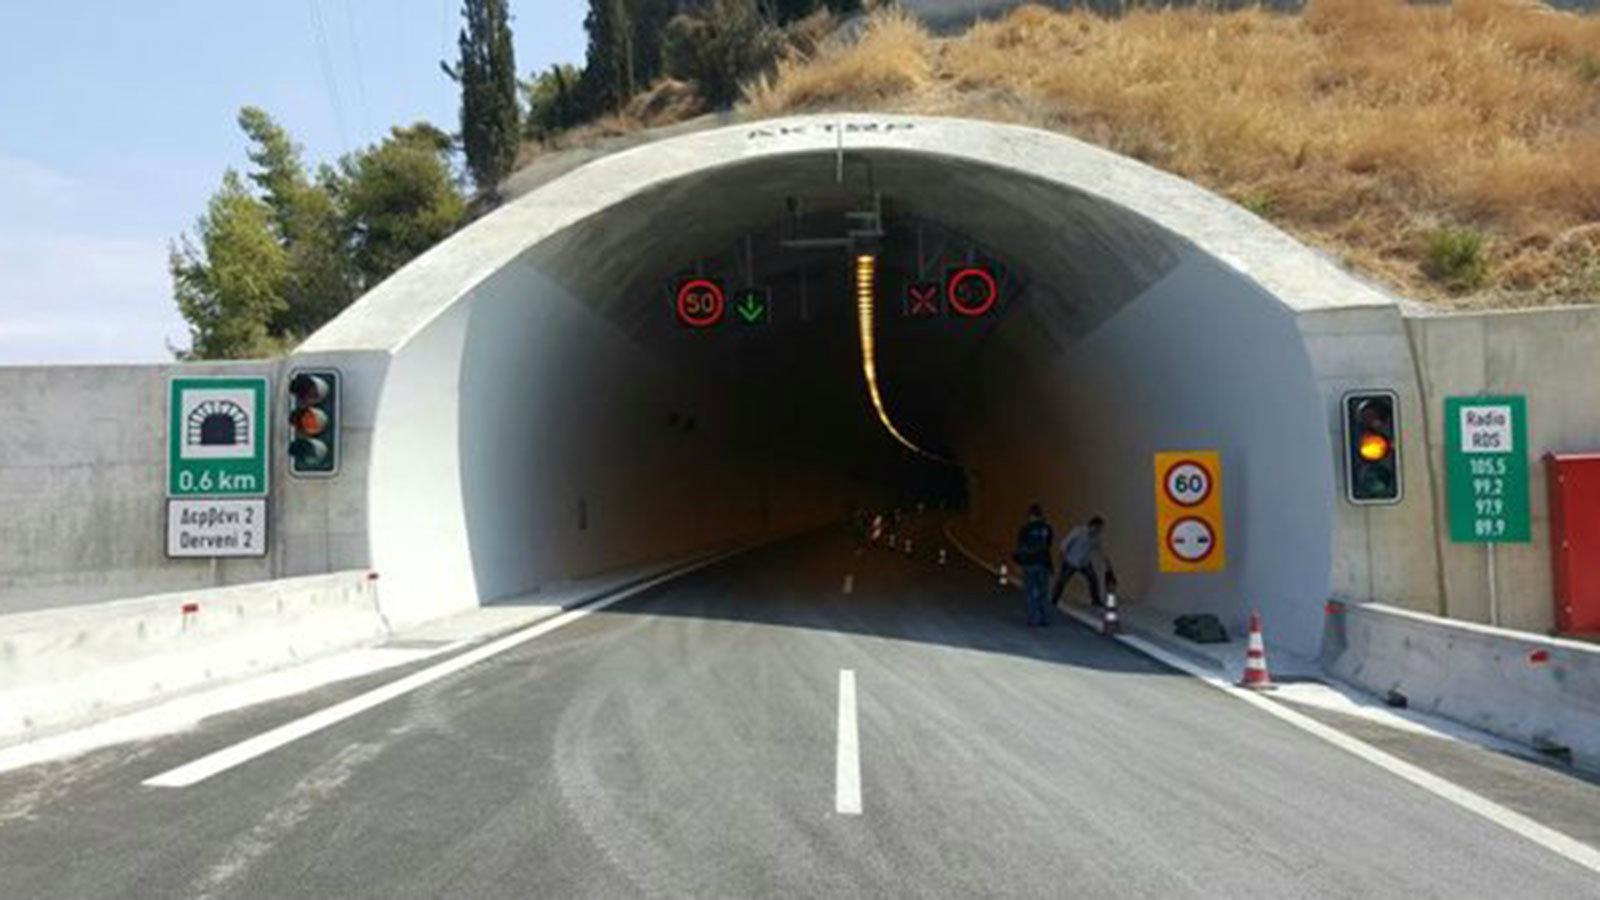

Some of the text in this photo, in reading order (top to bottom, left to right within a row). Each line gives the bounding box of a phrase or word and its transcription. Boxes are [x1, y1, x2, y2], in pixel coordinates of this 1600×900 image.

[686, 292, 716, 315] 50
[1466, 410, 1507, 427] Radio
[1469, 457, 1507, 475] 105.5
[178, 470, 256, 491] 0.6 km
[1175, 474, 1203, 494] 60
[246, 508, 255, 525] 2
[179, 531, 253, 549] Derveni 2
